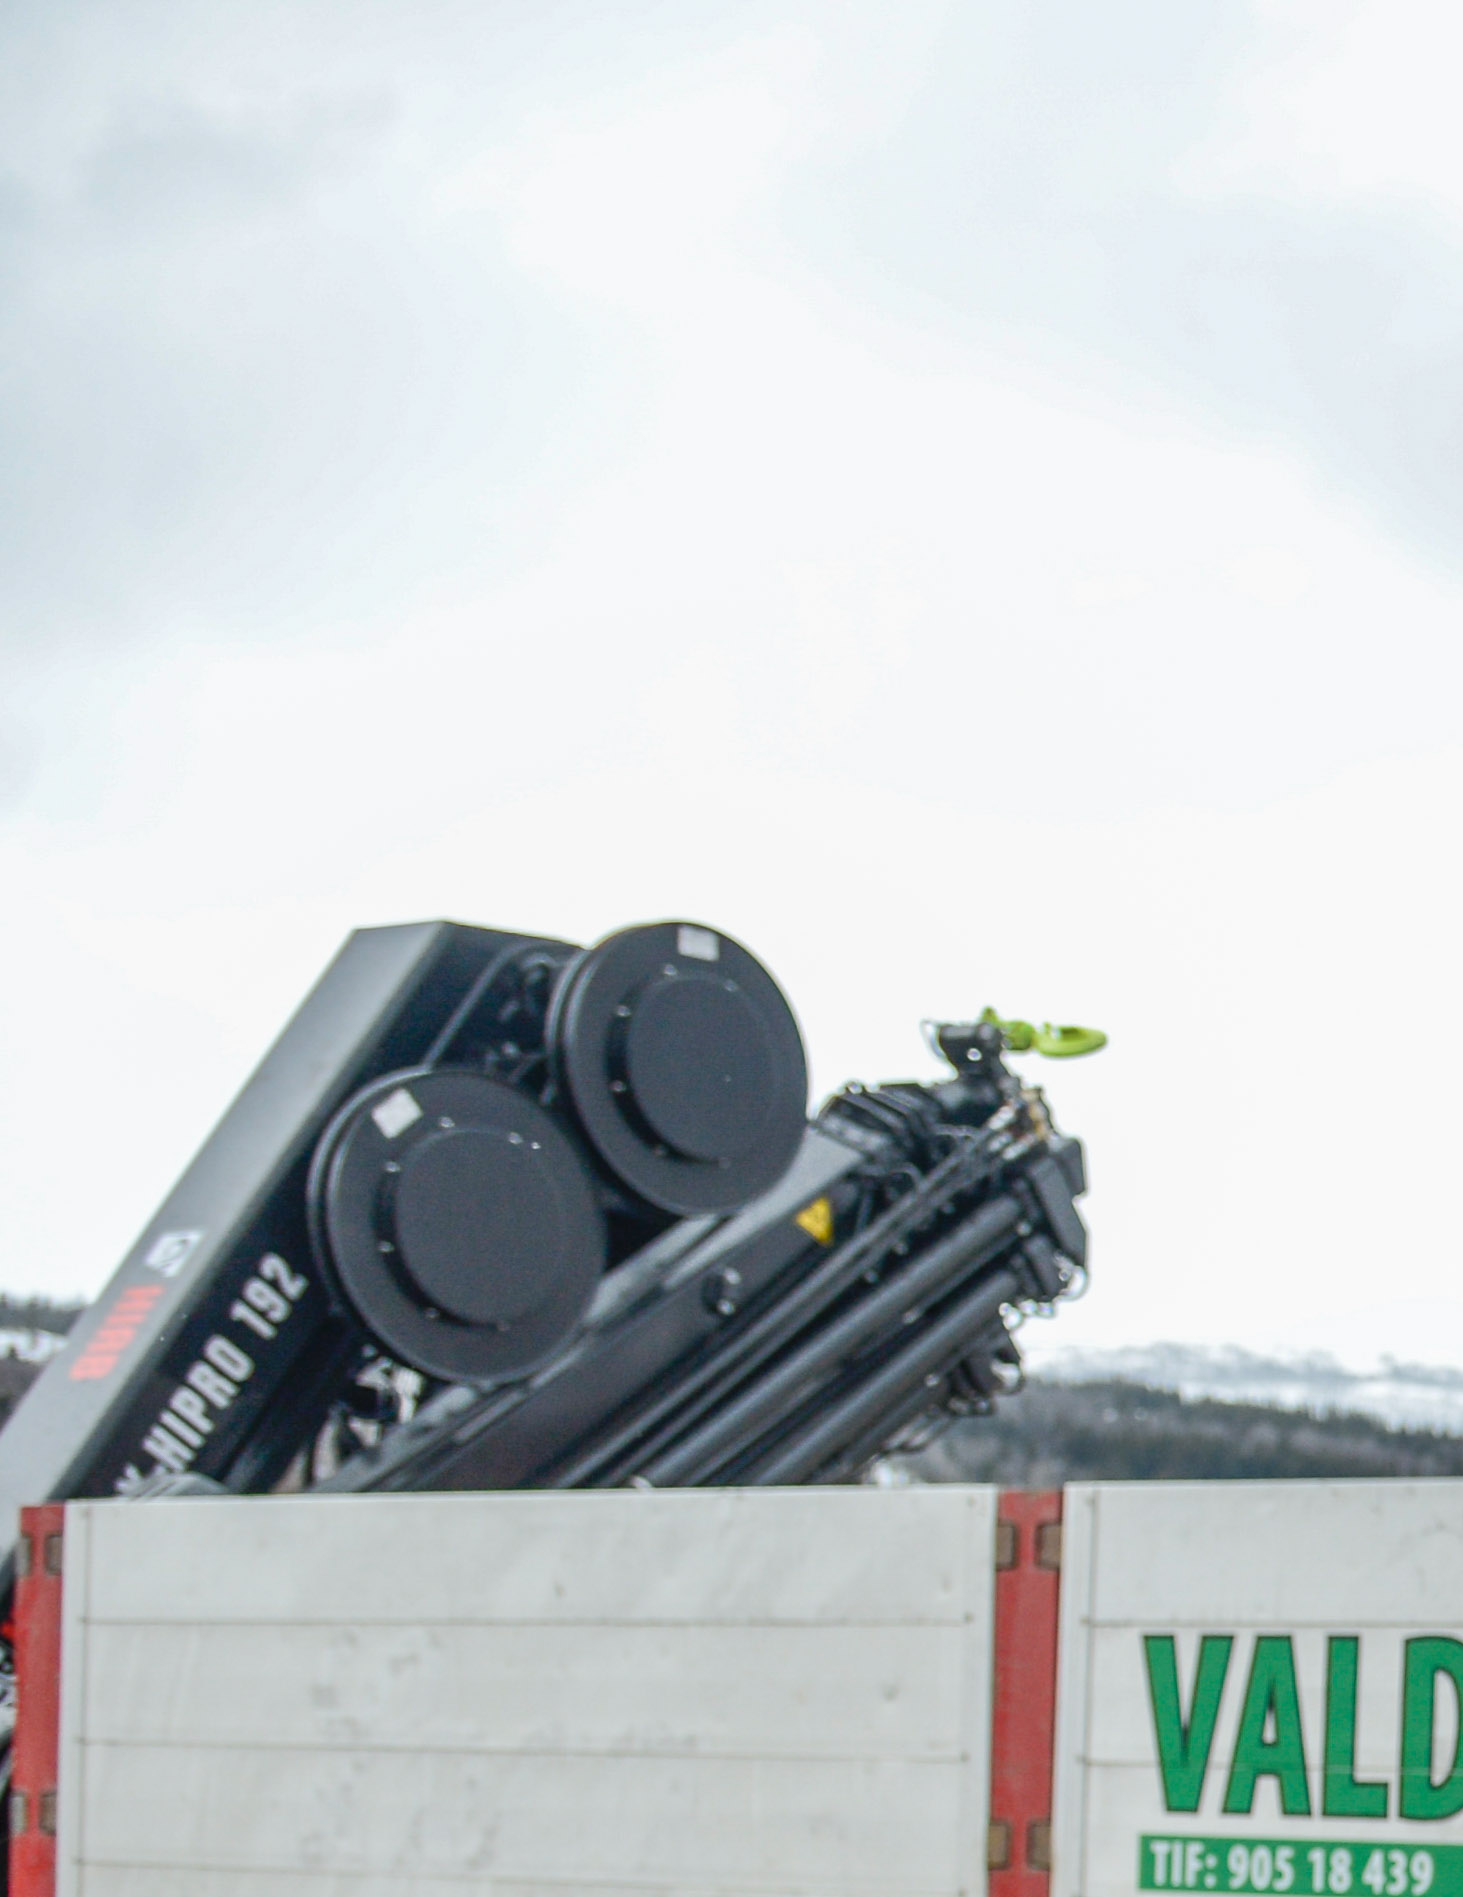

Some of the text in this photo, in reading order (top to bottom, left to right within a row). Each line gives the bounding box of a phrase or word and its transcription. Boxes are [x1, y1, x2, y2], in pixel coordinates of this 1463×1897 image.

[228, 1252, 309, 1340] 192
[1228, 1844, 1295, 1891] 905
[1308, 1847, 1352, 1894] 18
[1362, 1850, 1434, 1896] 439
